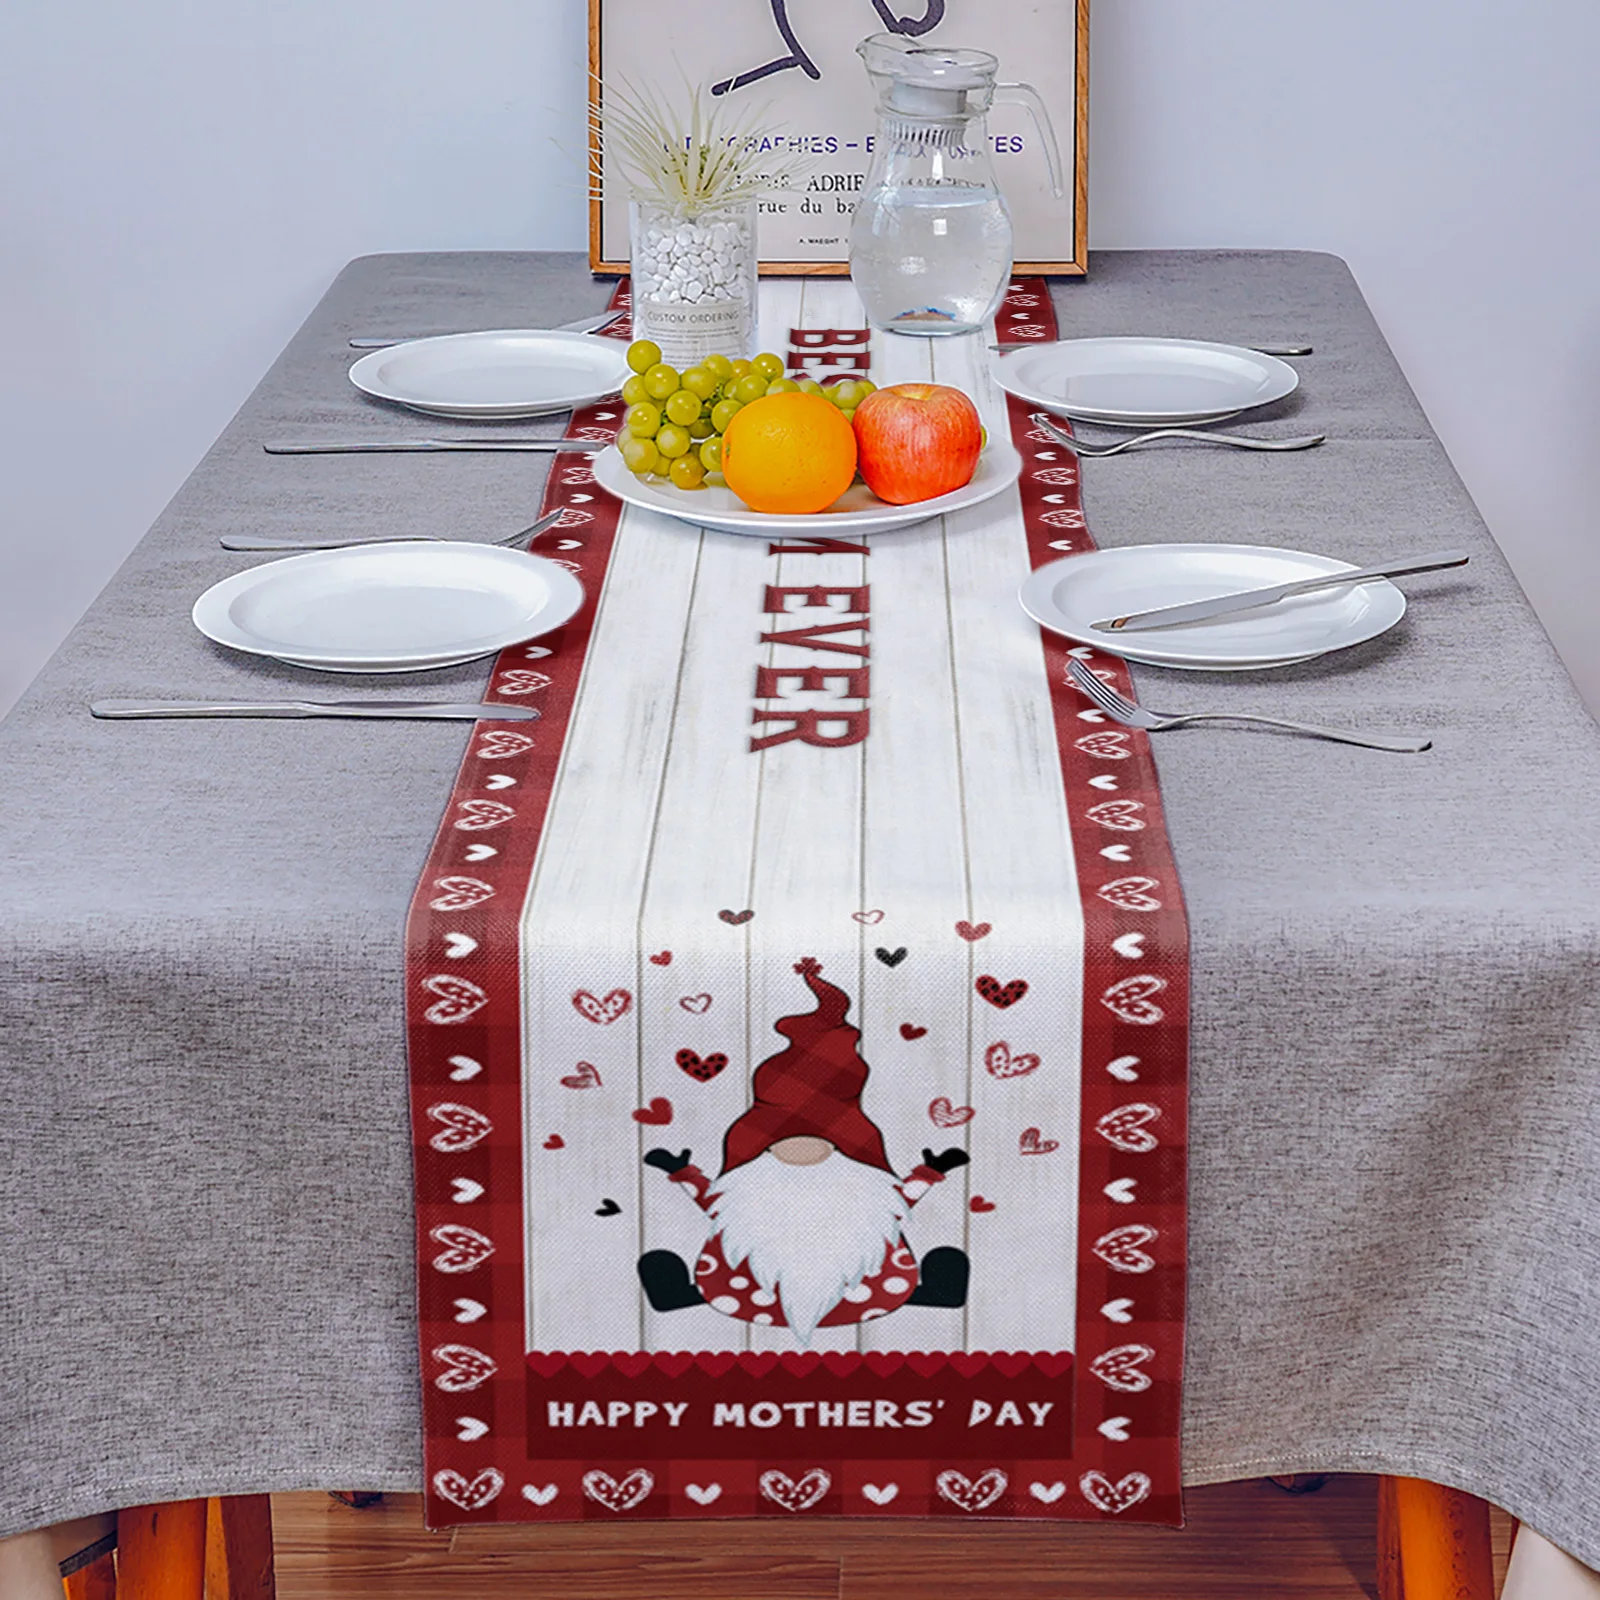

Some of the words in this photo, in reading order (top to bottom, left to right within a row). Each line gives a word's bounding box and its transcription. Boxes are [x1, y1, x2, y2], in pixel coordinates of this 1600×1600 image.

[758, 202, 787, 213] rue
[800, 197, 822, 214] du
[647, 311, 686, 323] CUSTOM
[689, 310, 740, 324] ORDERING
[749, 584, 871, 754] EVER
[547, 1400, 689, 1428] HAPPY
[713, 1400, 947, 1429] MOTHERS'
[968, 1399, 1054, 1428] DAY
